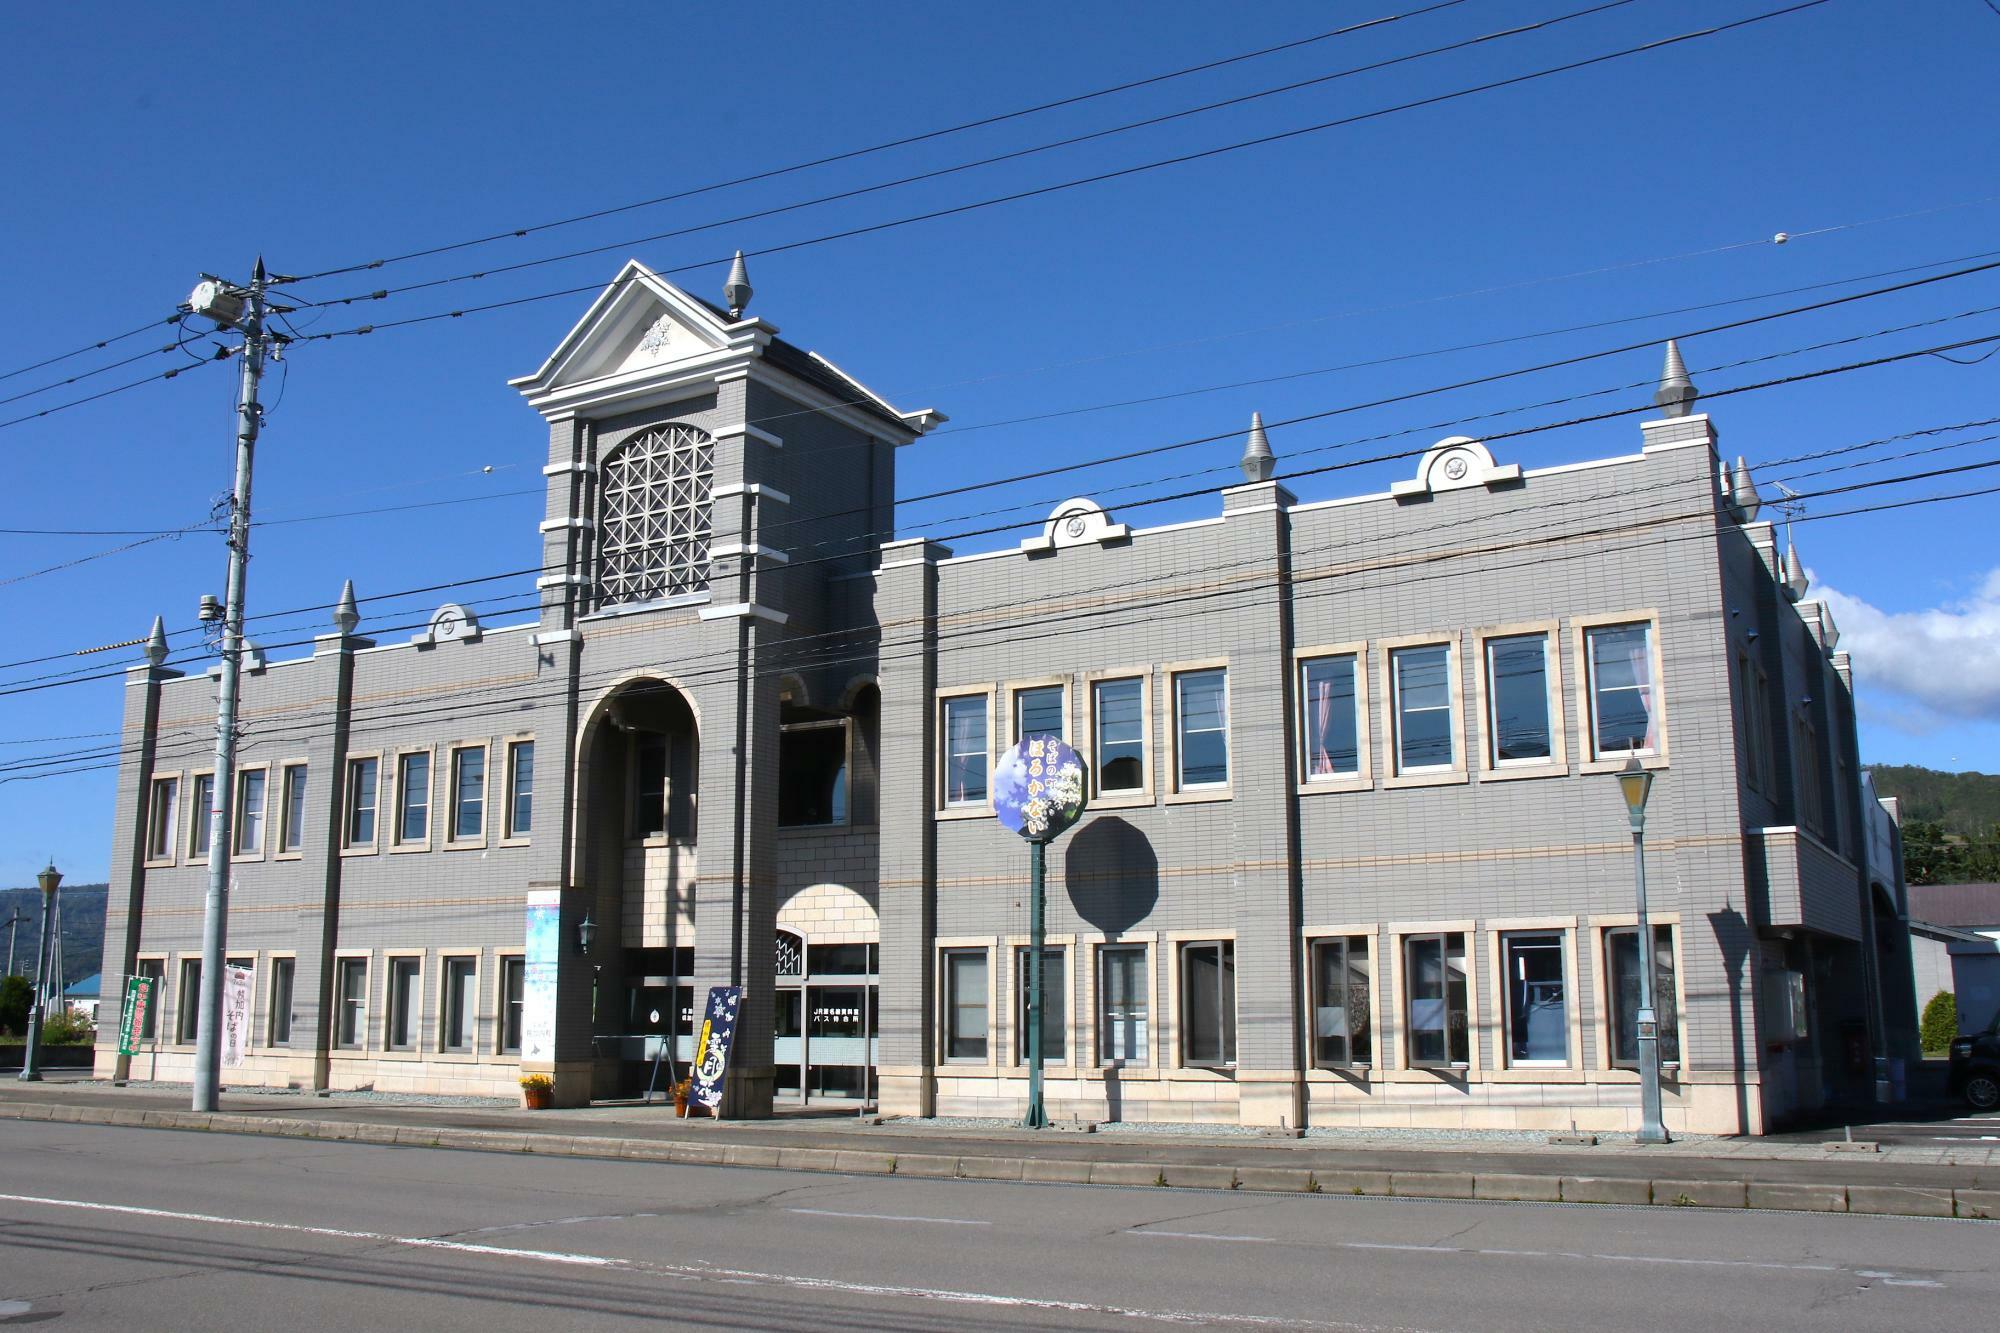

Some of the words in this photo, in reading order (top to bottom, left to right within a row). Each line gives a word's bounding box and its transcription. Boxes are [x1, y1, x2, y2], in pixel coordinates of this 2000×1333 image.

[1027, 739, 1045, 836] ほろかない
[1045, 740, 1058, 790] そばの町
